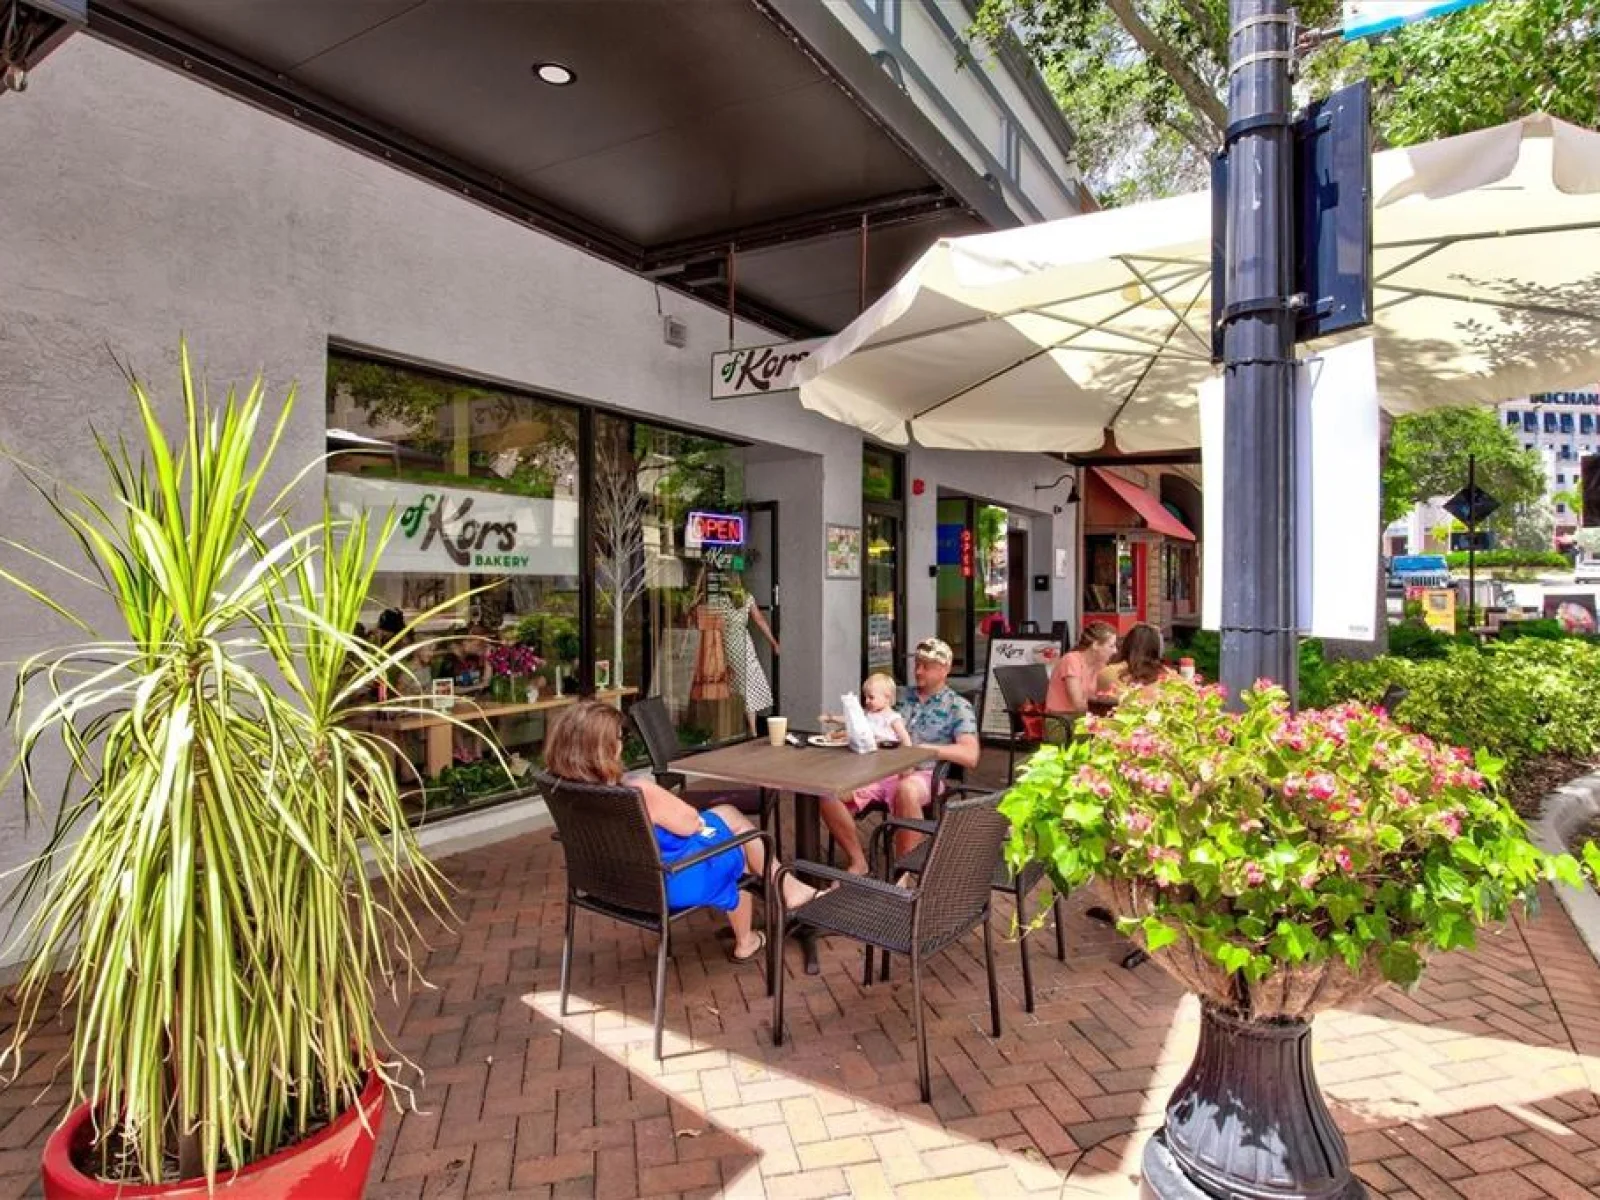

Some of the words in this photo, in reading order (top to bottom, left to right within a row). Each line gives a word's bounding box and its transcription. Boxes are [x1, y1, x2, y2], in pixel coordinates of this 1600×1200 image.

[721, 350, 745, 382] of
[400, 493, 436, 538] of
[420, 494, 518, 567] Kors
[692, 516, 740, 540] OPEN
[474, 554, 530, 568] BAKERY
